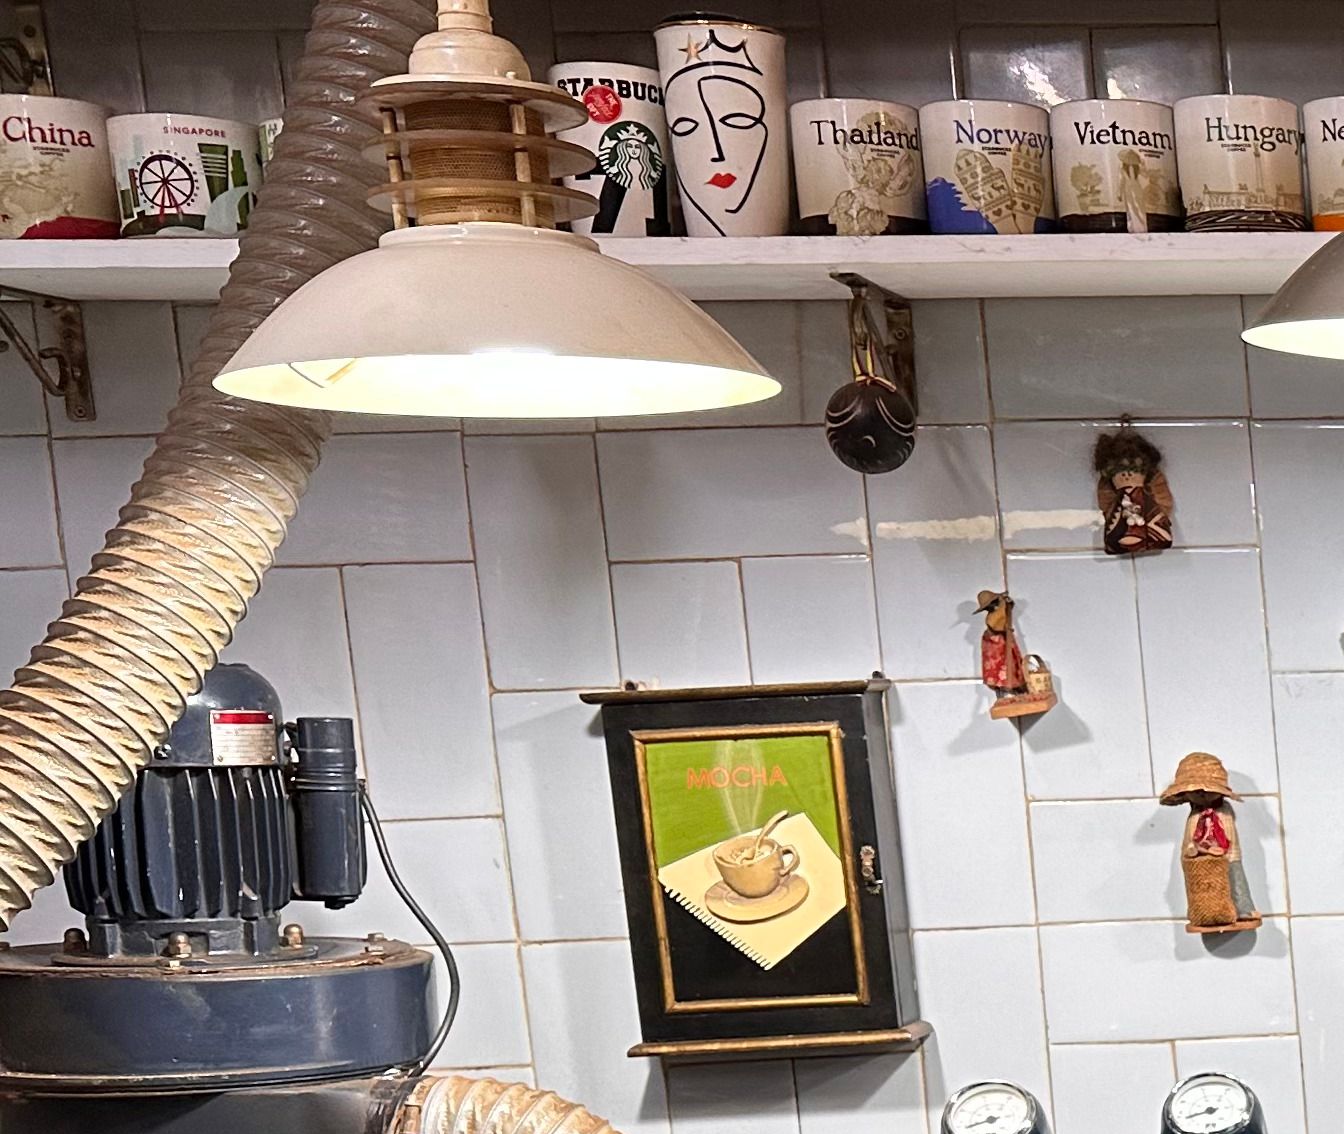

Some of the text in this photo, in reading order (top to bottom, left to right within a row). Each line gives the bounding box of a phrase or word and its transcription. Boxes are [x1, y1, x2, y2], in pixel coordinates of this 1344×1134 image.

[2, 115, 95, 148] China
[163, 125, 227, 138] SINGAPORE
[809, 119, 920, 151] Thailand
[953, 119, 1048, 159] Norway
[1074, 119, 1173, 151] Vietnam
[1204, 117, 1301, 156] Hungary
[686, 765, 788, 790] MOCHA
